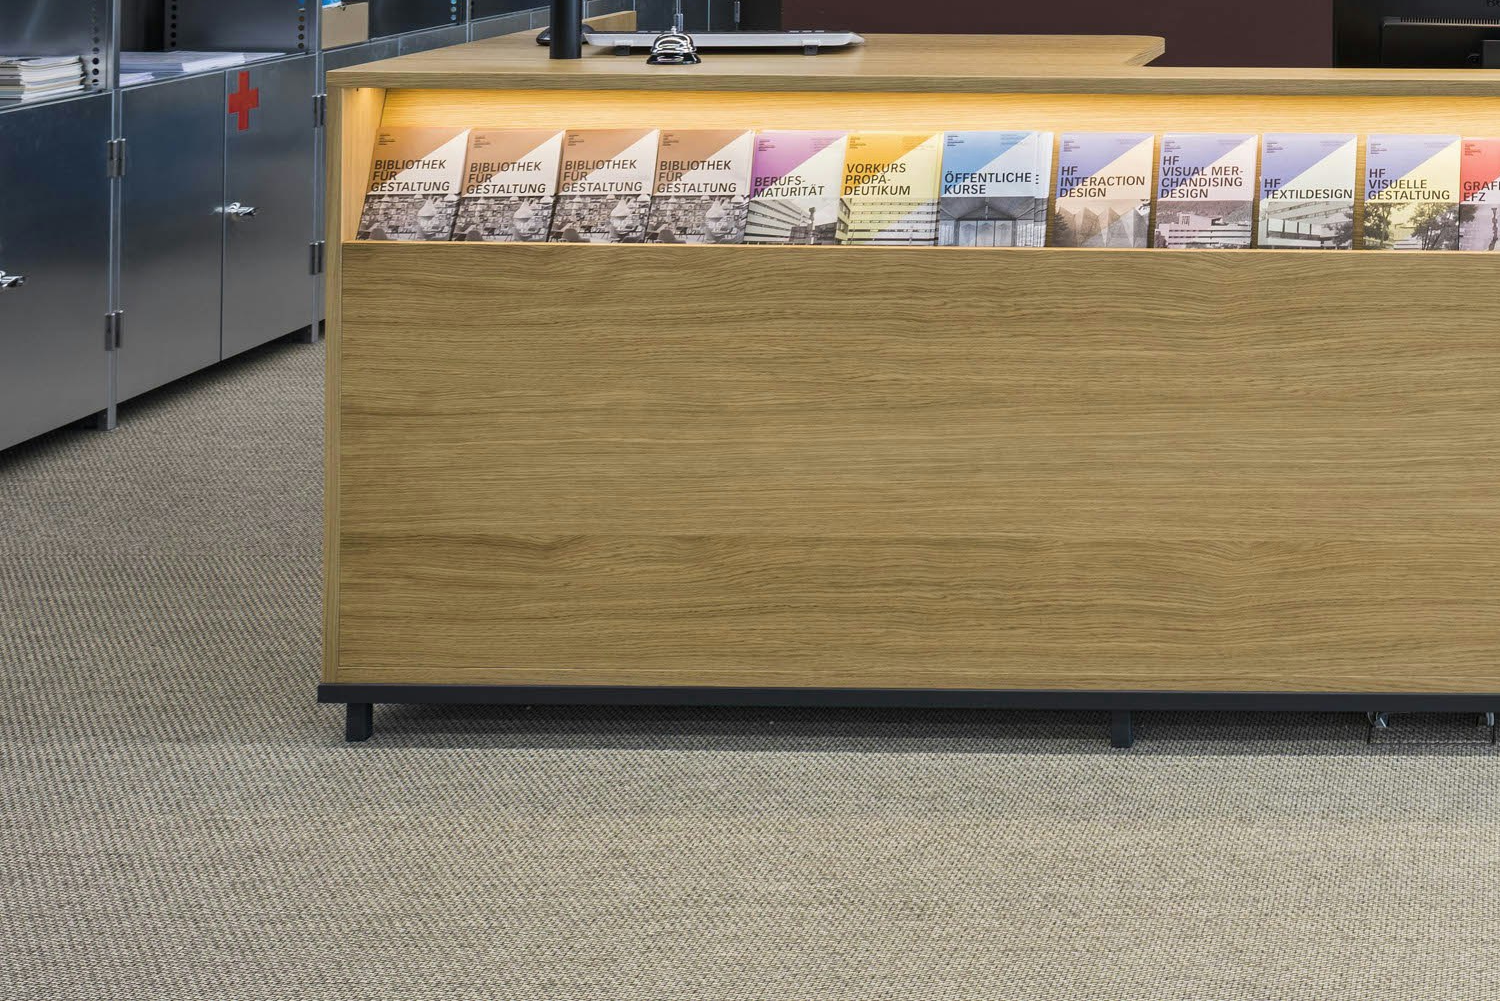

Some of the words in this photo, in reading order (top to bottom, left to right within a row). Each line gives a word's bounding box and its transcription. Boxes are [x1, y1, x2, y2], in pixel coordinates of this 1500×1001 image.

[375, 160, 447, 170] BIBLIOTHEK
[565, 160, 636, 170] BIBLIOTHEK
[660, 160, 731, 170] BIBLIOTHEK
[1163, 156, 1179, 165] HF
[470, 161, 542, 172] BIBLIOTHEK
[847, 163, 906, 173] VORKURS
[1062, 166, 1077, 175] HF
[1163, 167, 1207, 176] VISUAL
[1211, 166, 1243, 175] MER-
[373, 170, 397, 181] FÜR
[469, 172, 492, 183] FÜR
[563, 171, 588, 181] FÜR
[658, 171, 683, 182] FÜR
[845, 172, 890, 184] PROPÄ-
[945, 170, 1031, 183] ÖFFENTLICHE
[1369, 169, 1385, 178] HF
[755, 176, 806, 186] BERUFS-
[1060, 176, 1145, 186] INTERACTION
[1161, 177, 1242, 187] CHANDISING
[1264, 179, 1281, 188] HF
[1369, 180, 1427, 189] VISUELLE
[371, 182, 450, 192] GESTALTUNG
[466, 184, 546, 194] GESTALTUNG
[562, 182, 642, 192] GESTALTUNG
[657, 183, 737, 193] GESTALTUNG
[753, 184, 825, 197] MATURITÄT
[844, 186, 911, 196] DEUTIKUM
[944, 184, 986, 194] KURSE
[1059, 188, 1106, 197] DESIGN
[1161, 189, 1208, 198] DESIGN
[1264, 189, 1352, 199] TEXTILDESIGN
[1368, 190, 1450, 200] GESTALTUNG
[1464, 192, 1485, 202] EFZ
